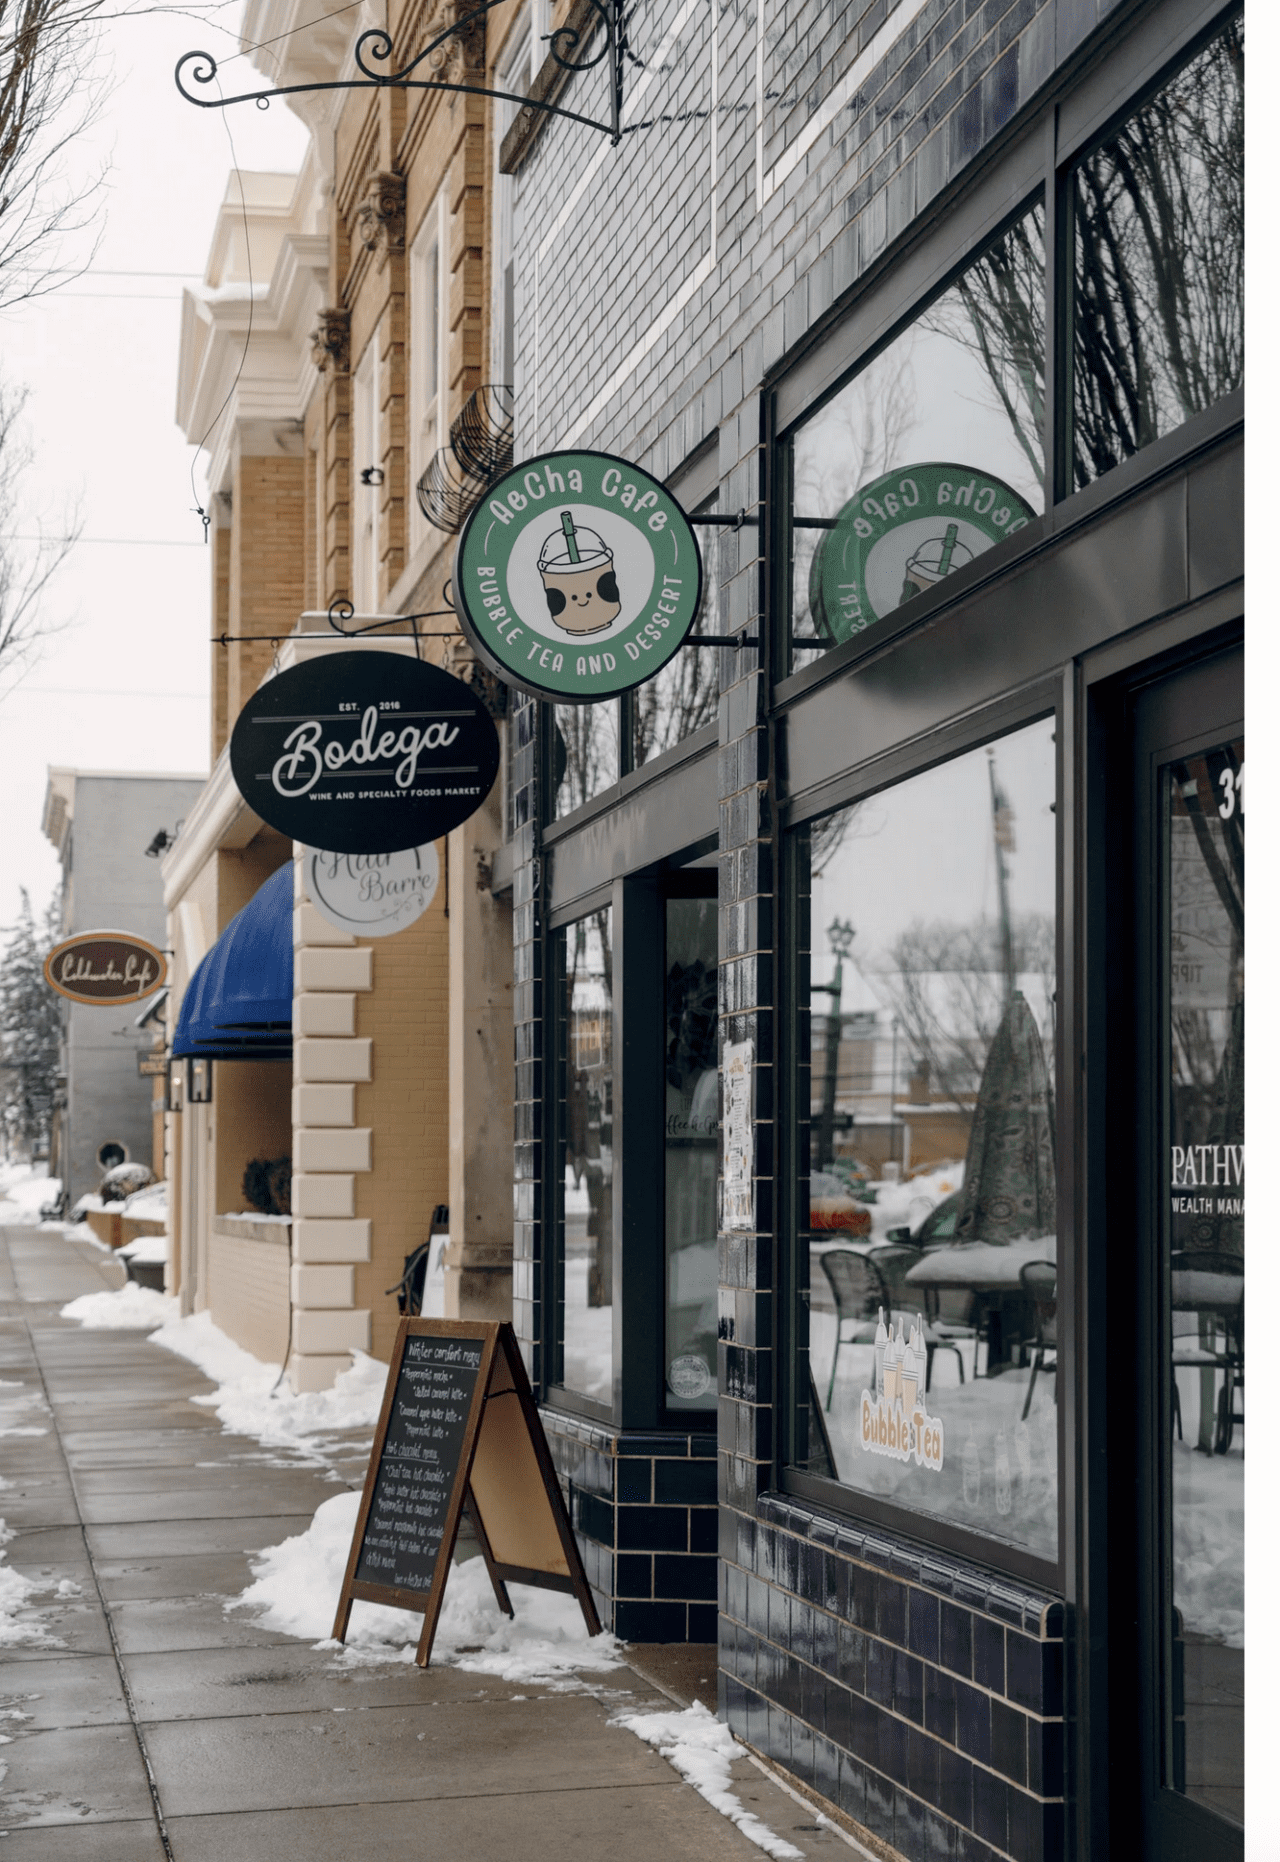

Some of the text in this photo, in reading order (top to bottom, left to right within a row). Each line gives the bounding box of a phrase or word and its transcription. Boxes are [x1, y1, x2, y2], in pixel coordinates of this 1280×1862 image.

[601, 468, 668, 532] Cafe
[477, 566, 683, 676] BUBBLE TEA AND DESSERT
[338, 702, 360, 711] EST.
[271, 705, 460, 798] Bodega
[309, 786, 480, 801] WINE AND SPECIALTY FOODS MARKET
[358, 869, 434, 902] Barre
[1171, 1196, 1213, 1214] WEALTH
[434, 1344, 462, 1361] comfort
[862, 1399, 941, 1462] Bubble Tea
